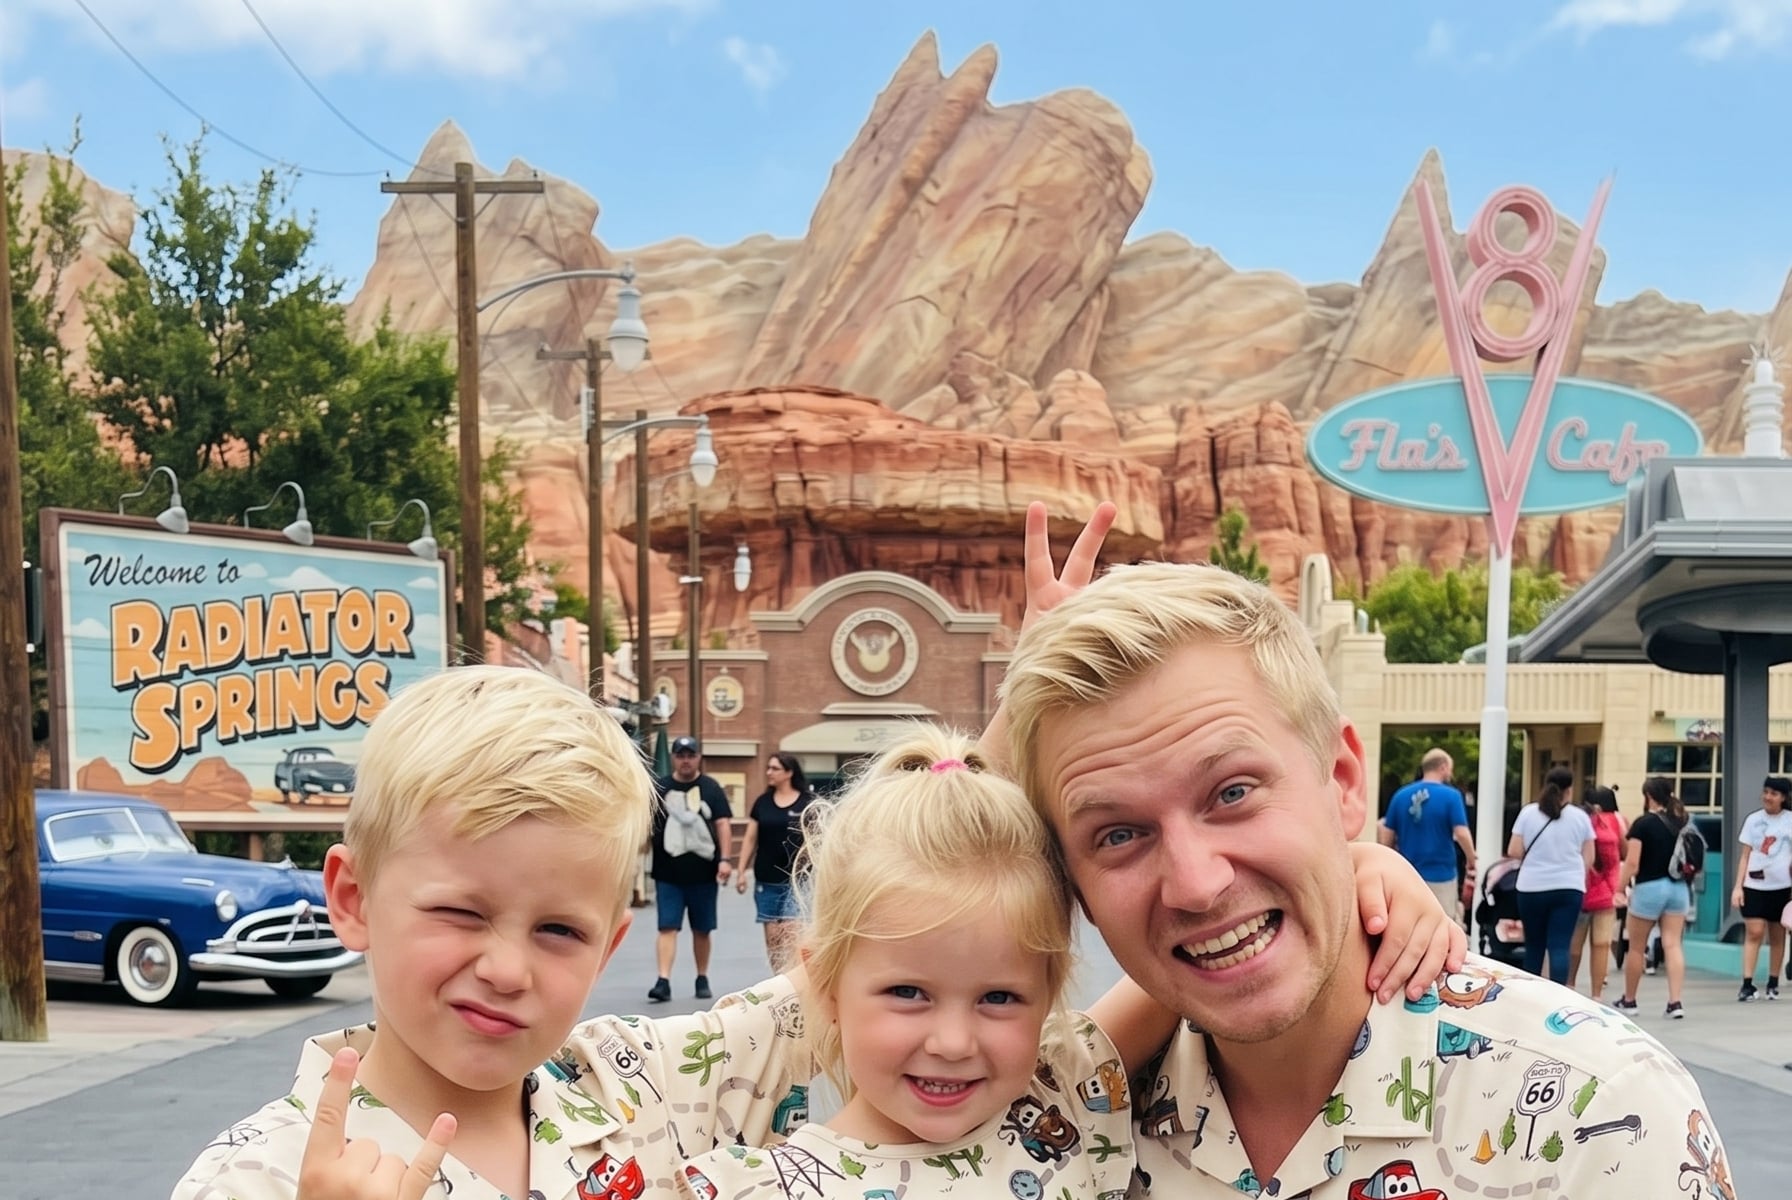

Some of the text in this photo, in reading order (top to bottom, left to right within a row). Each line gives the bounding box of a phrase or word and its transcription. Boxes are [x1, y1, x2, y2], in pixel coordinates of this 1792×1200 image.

[84, 553, 241, 587] Welcome to
[111, 588, 415, 691] RADIATOR
[129, 659, 391, 774] SPRINGS
[1525, 1080, 1556, 1105] 66
